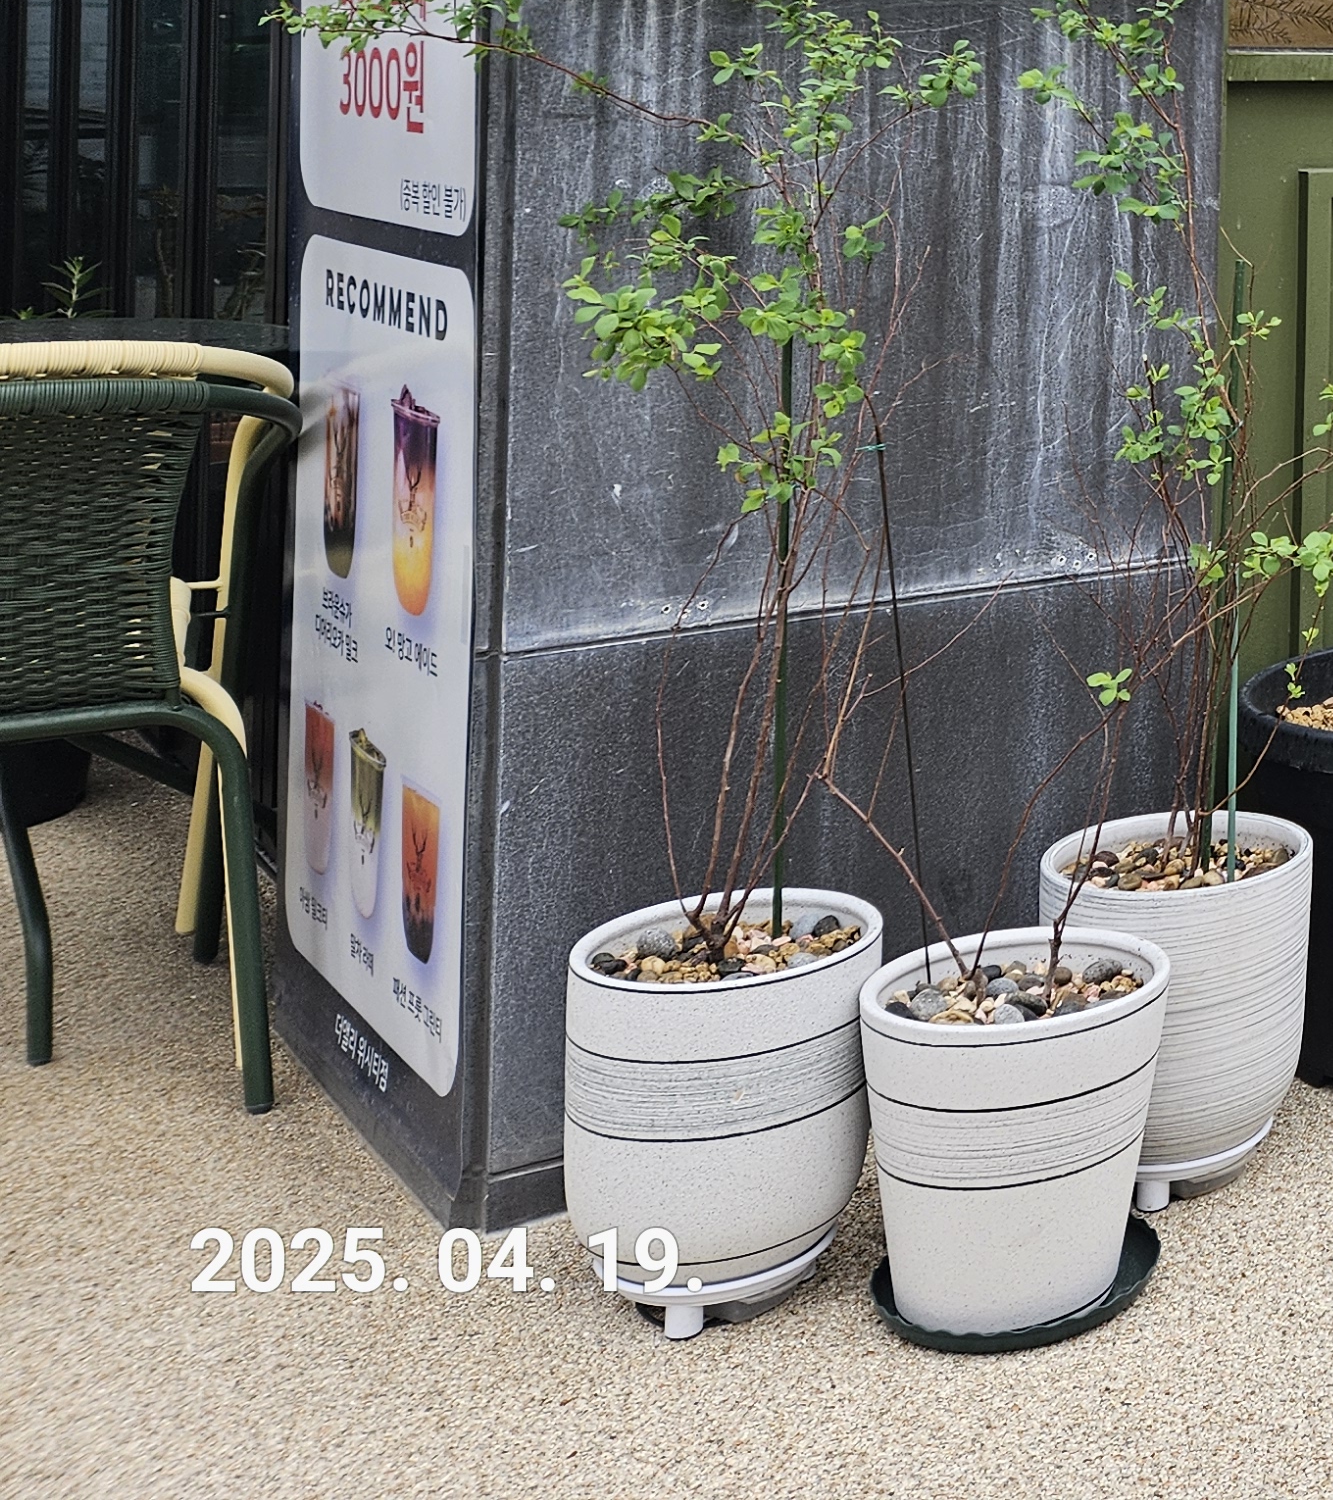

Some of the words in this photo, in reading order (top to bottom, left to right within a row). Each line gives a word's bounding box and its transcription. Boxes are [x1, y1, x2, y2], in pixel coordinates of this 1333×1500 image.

[339, 41, 424, 134] 3000원
[400, 177, 420, 213] (중복
[422, 181, 441, 217] 할인
[444, 185, 466, 223] 불가)
[325, 268, 448, 341] RECOMMEND
[322, 586, 352, 629] 브라운슈가
[397, 632, 413, 662] 망고
[414, 642, 438, 677] 에이드
[357, 1035, 389, 1093] 위시티점
